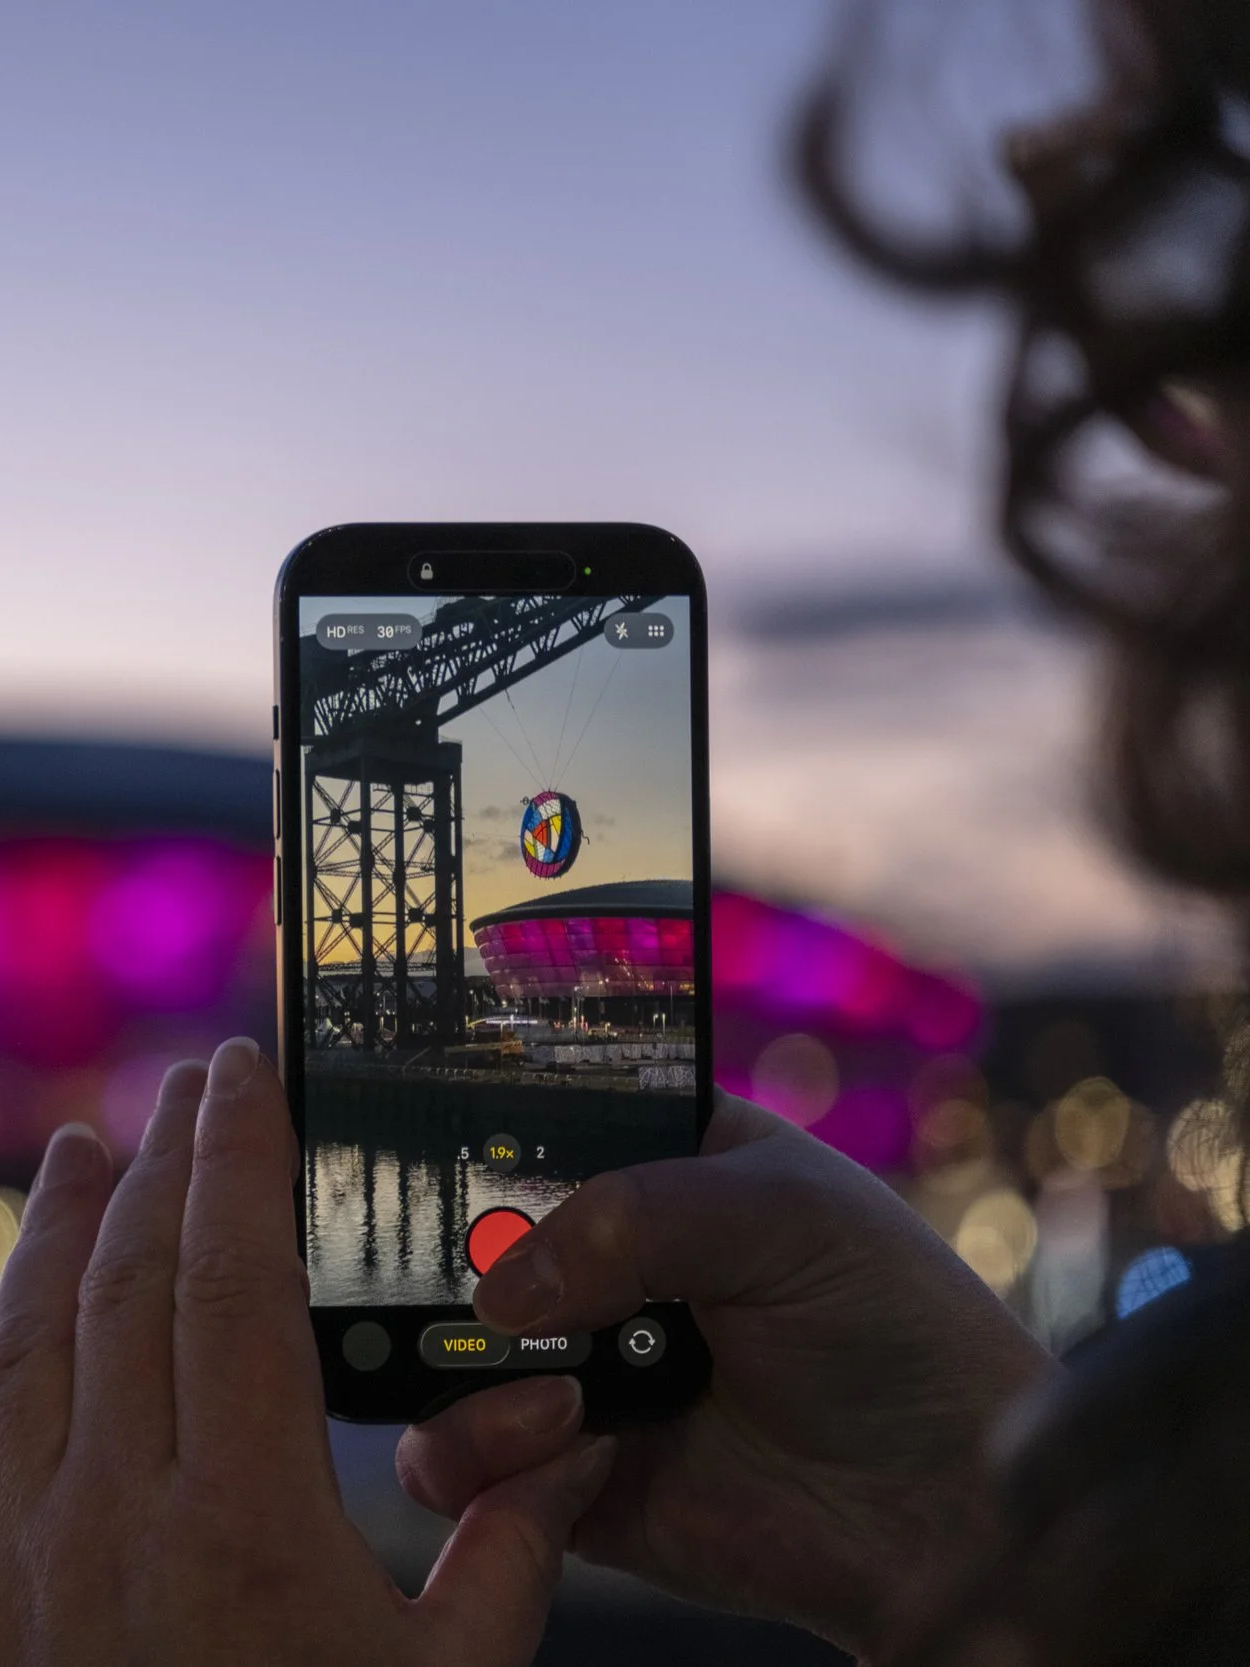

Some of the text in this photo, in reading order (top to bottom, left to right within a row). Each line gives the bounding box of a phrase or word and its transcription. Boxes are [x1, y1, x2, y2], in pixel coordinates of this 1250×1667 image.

[489, 1146, 515, 1160] 1.9x
[536, 1146, 545, 1159] 2
[443, 1338, 486, 1352] VIDEO
[521, 1337, 568, 1351] PHOTO
